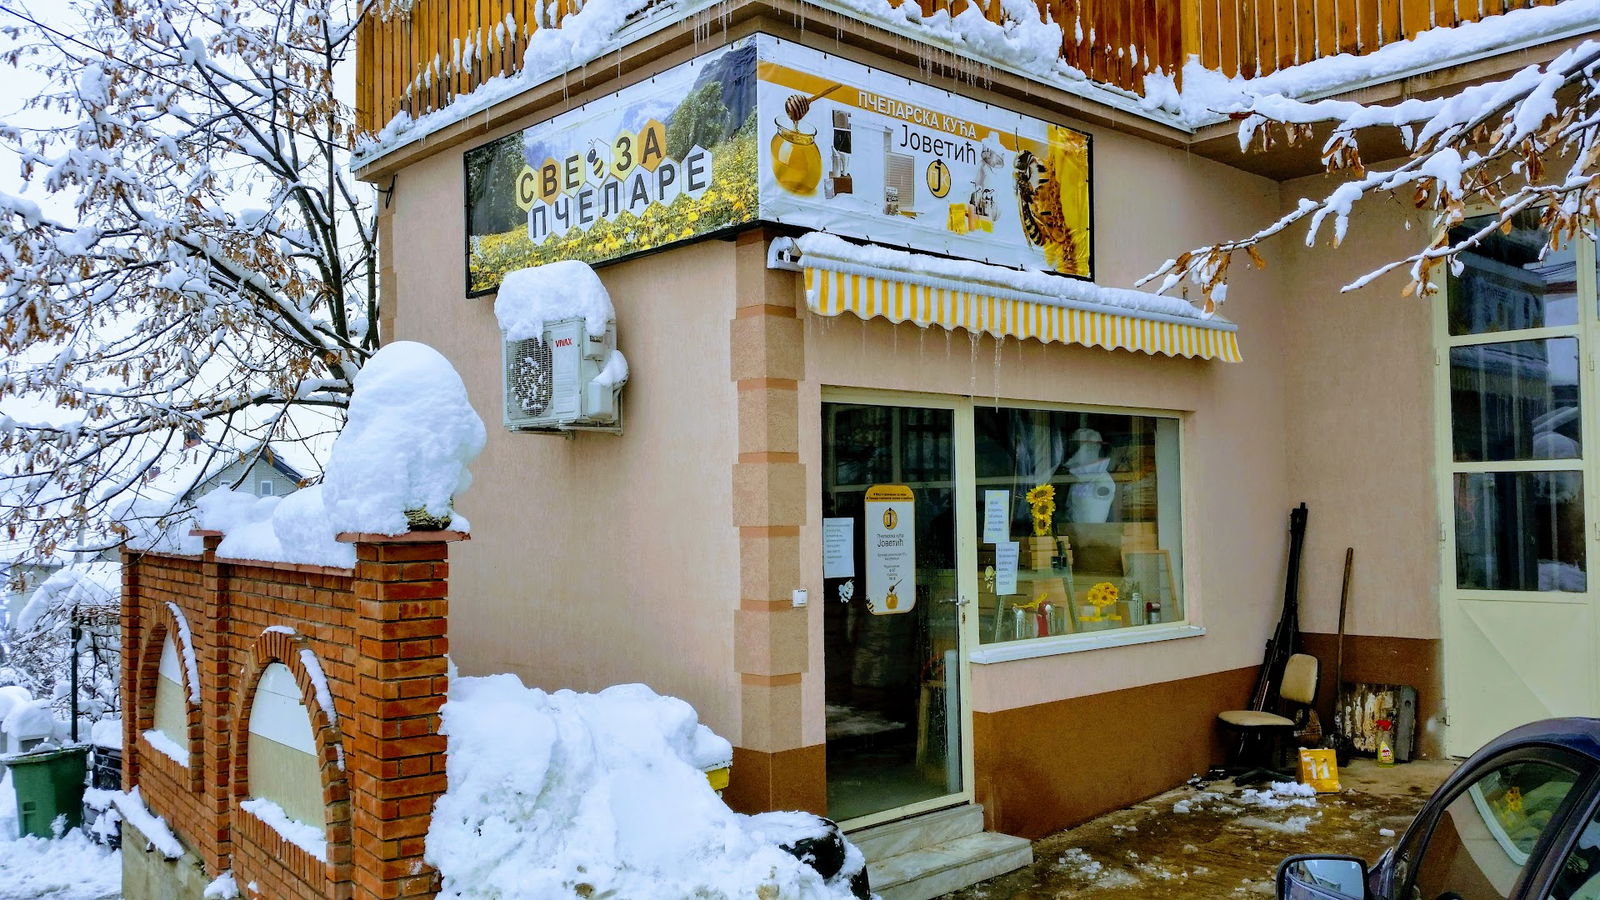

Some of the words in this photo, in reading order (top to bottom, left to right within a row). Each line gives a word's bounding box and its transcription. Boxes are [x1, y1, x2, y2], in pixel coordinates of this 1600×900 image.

[858, 90, 939, 129] ПЧЕЛАРСКА
[943, 115, 977, 139] КУЋА
[520, 154, 580, 204] СВЕ
[616, 126, 662, 171] ЗА
[532, 152, 706, 239] ПЧЕЛАРЕ
[555, 337, 573, 348] VIVAX
